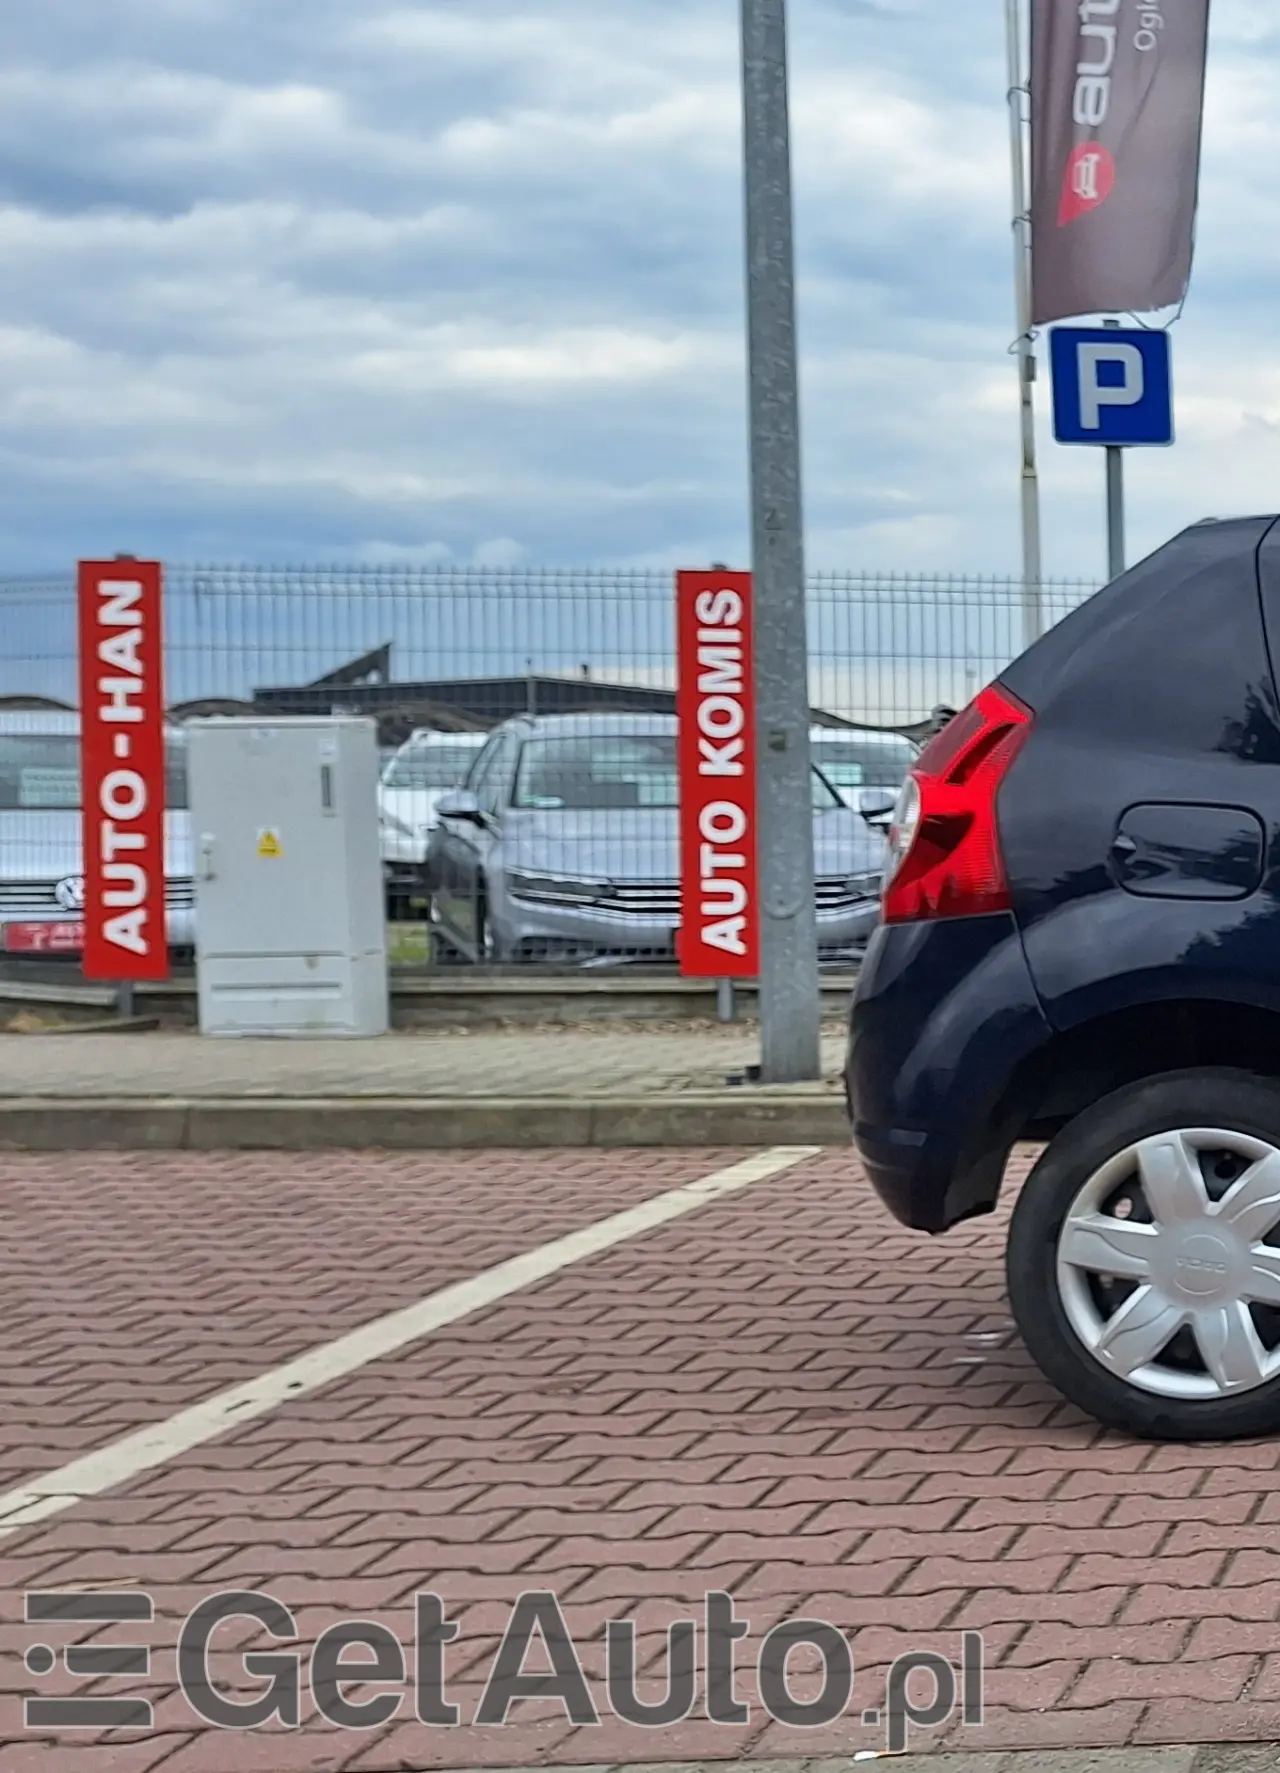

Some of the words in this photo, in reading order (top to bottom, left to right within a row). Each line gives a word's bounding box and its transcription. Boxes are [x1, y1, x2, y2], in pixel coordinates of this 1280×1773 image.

[1076, 341, 1144, 429] P
[695, 588, 745, 776] KOMIS
[699, 800, 748, 956] AUTO
